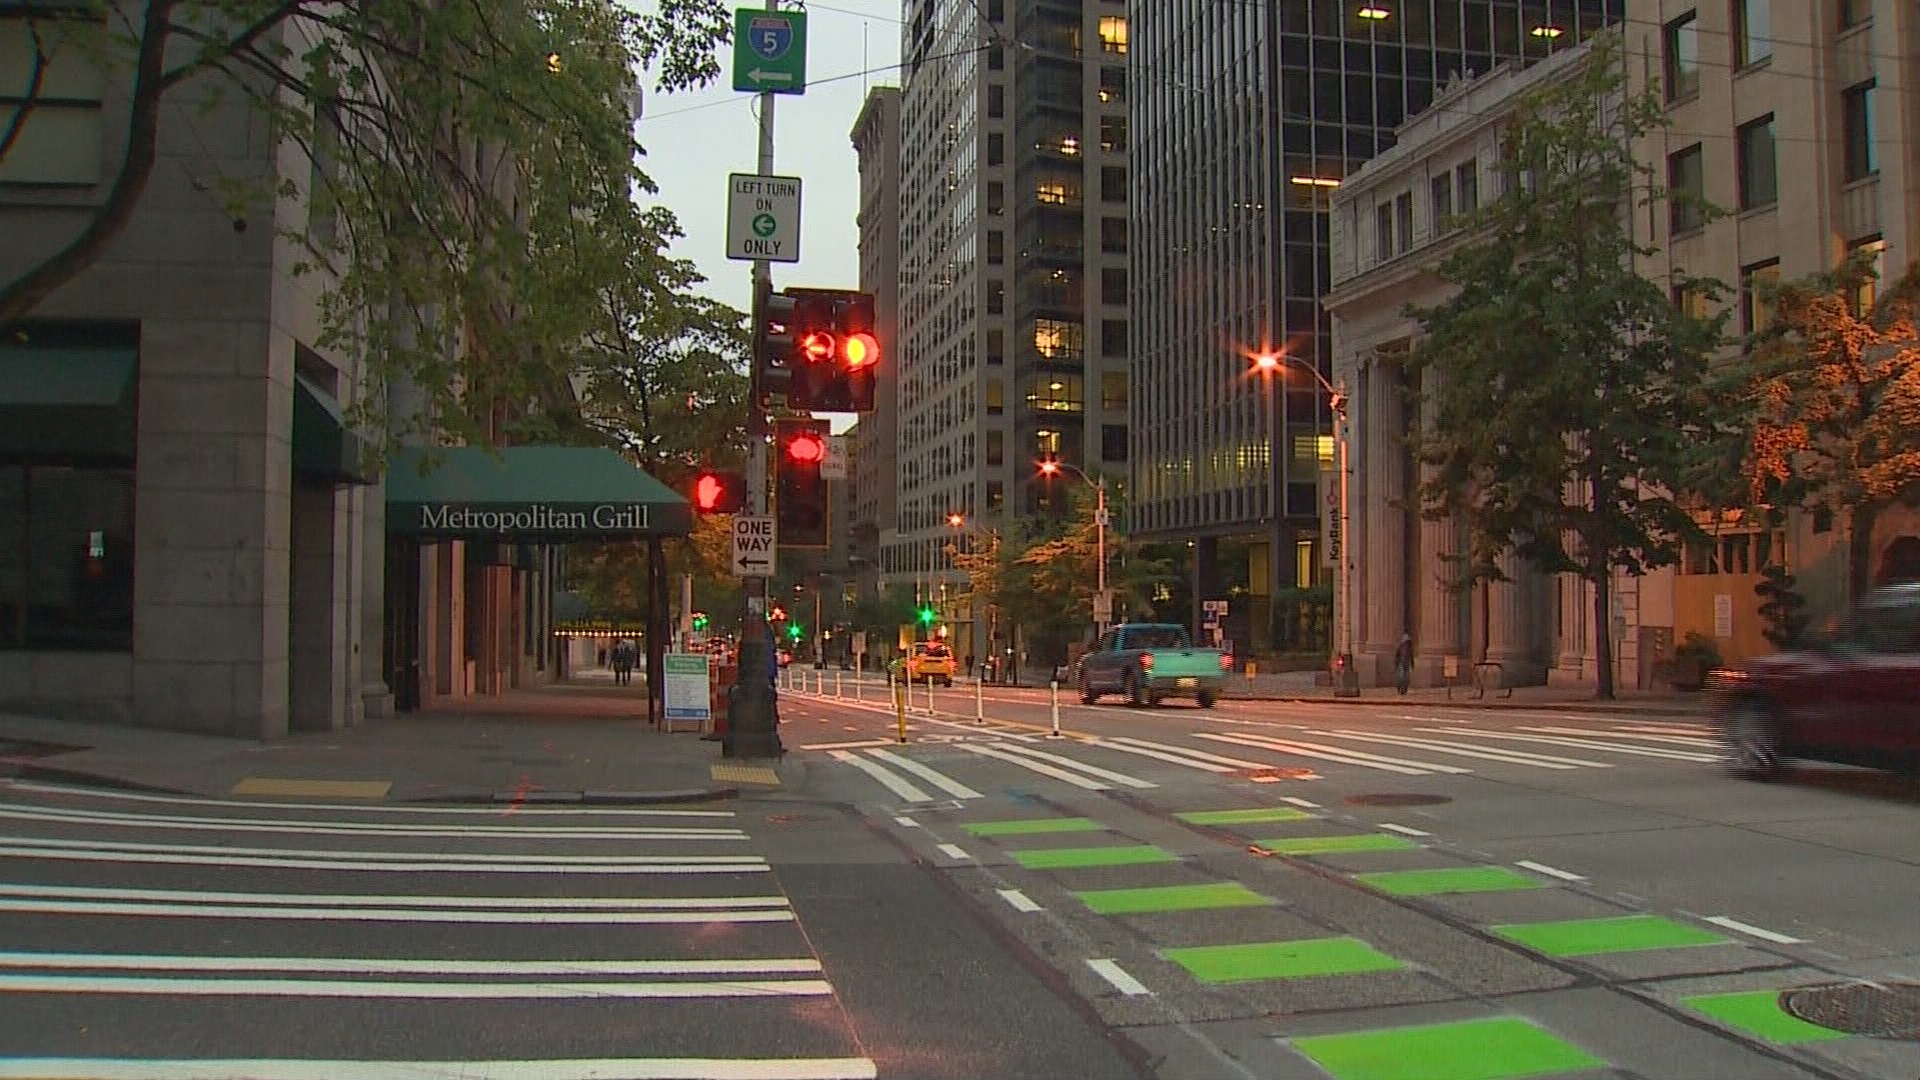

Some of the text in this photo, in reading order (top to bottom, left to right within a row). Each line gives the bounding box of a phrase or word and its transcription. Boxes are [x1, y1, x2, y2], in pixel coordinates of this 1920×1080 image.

[763, 31, 777, 52] 5
[736, 181, 795, 196] LEFT TURN
[756, 198, 772, 210] ON
[744, 239, 781, 255] ONLY
[421, 505, 649, 532] Metropolitan Grill
[737, 521, 771, 535] ONE
[1329, 508, 1340, 560] KeyBank
[737, 537, 772, 551] WAY
